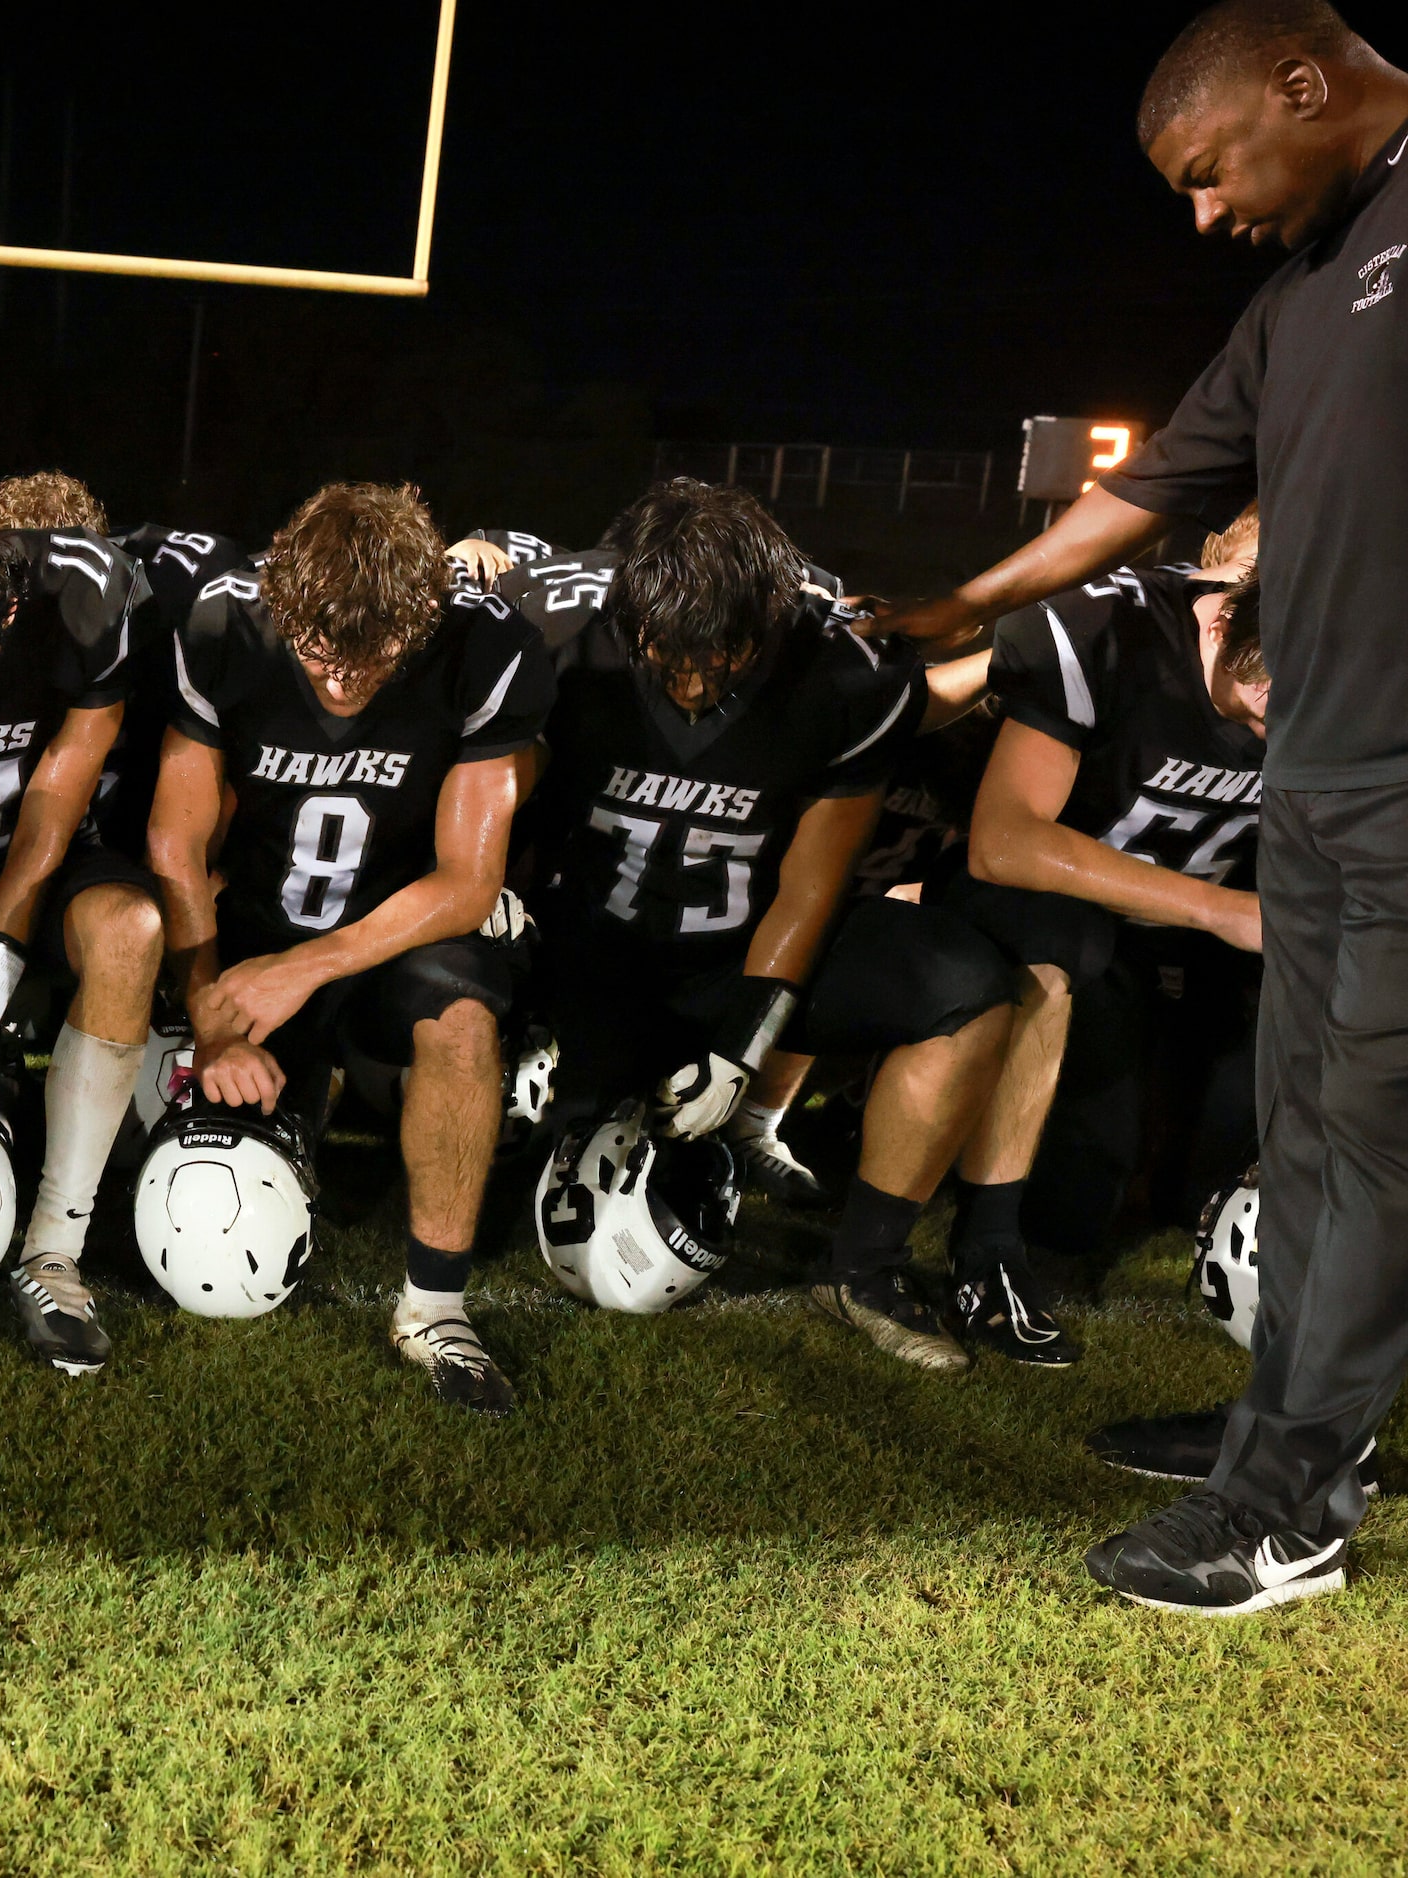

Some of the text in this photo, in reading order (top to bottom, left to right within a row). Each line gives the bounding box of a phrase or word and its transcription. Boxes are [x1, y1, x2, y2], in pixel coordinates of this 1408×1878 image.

[49, 533, 113, 597] 11
[252, 745, 411, 787] HAWKS
[603, 766, 760, 820] HAWKS
[281, 796, 371, 930] 8
[589, 806, 766, 933] 75
[183, 1134, 232, 1146] Riddell
